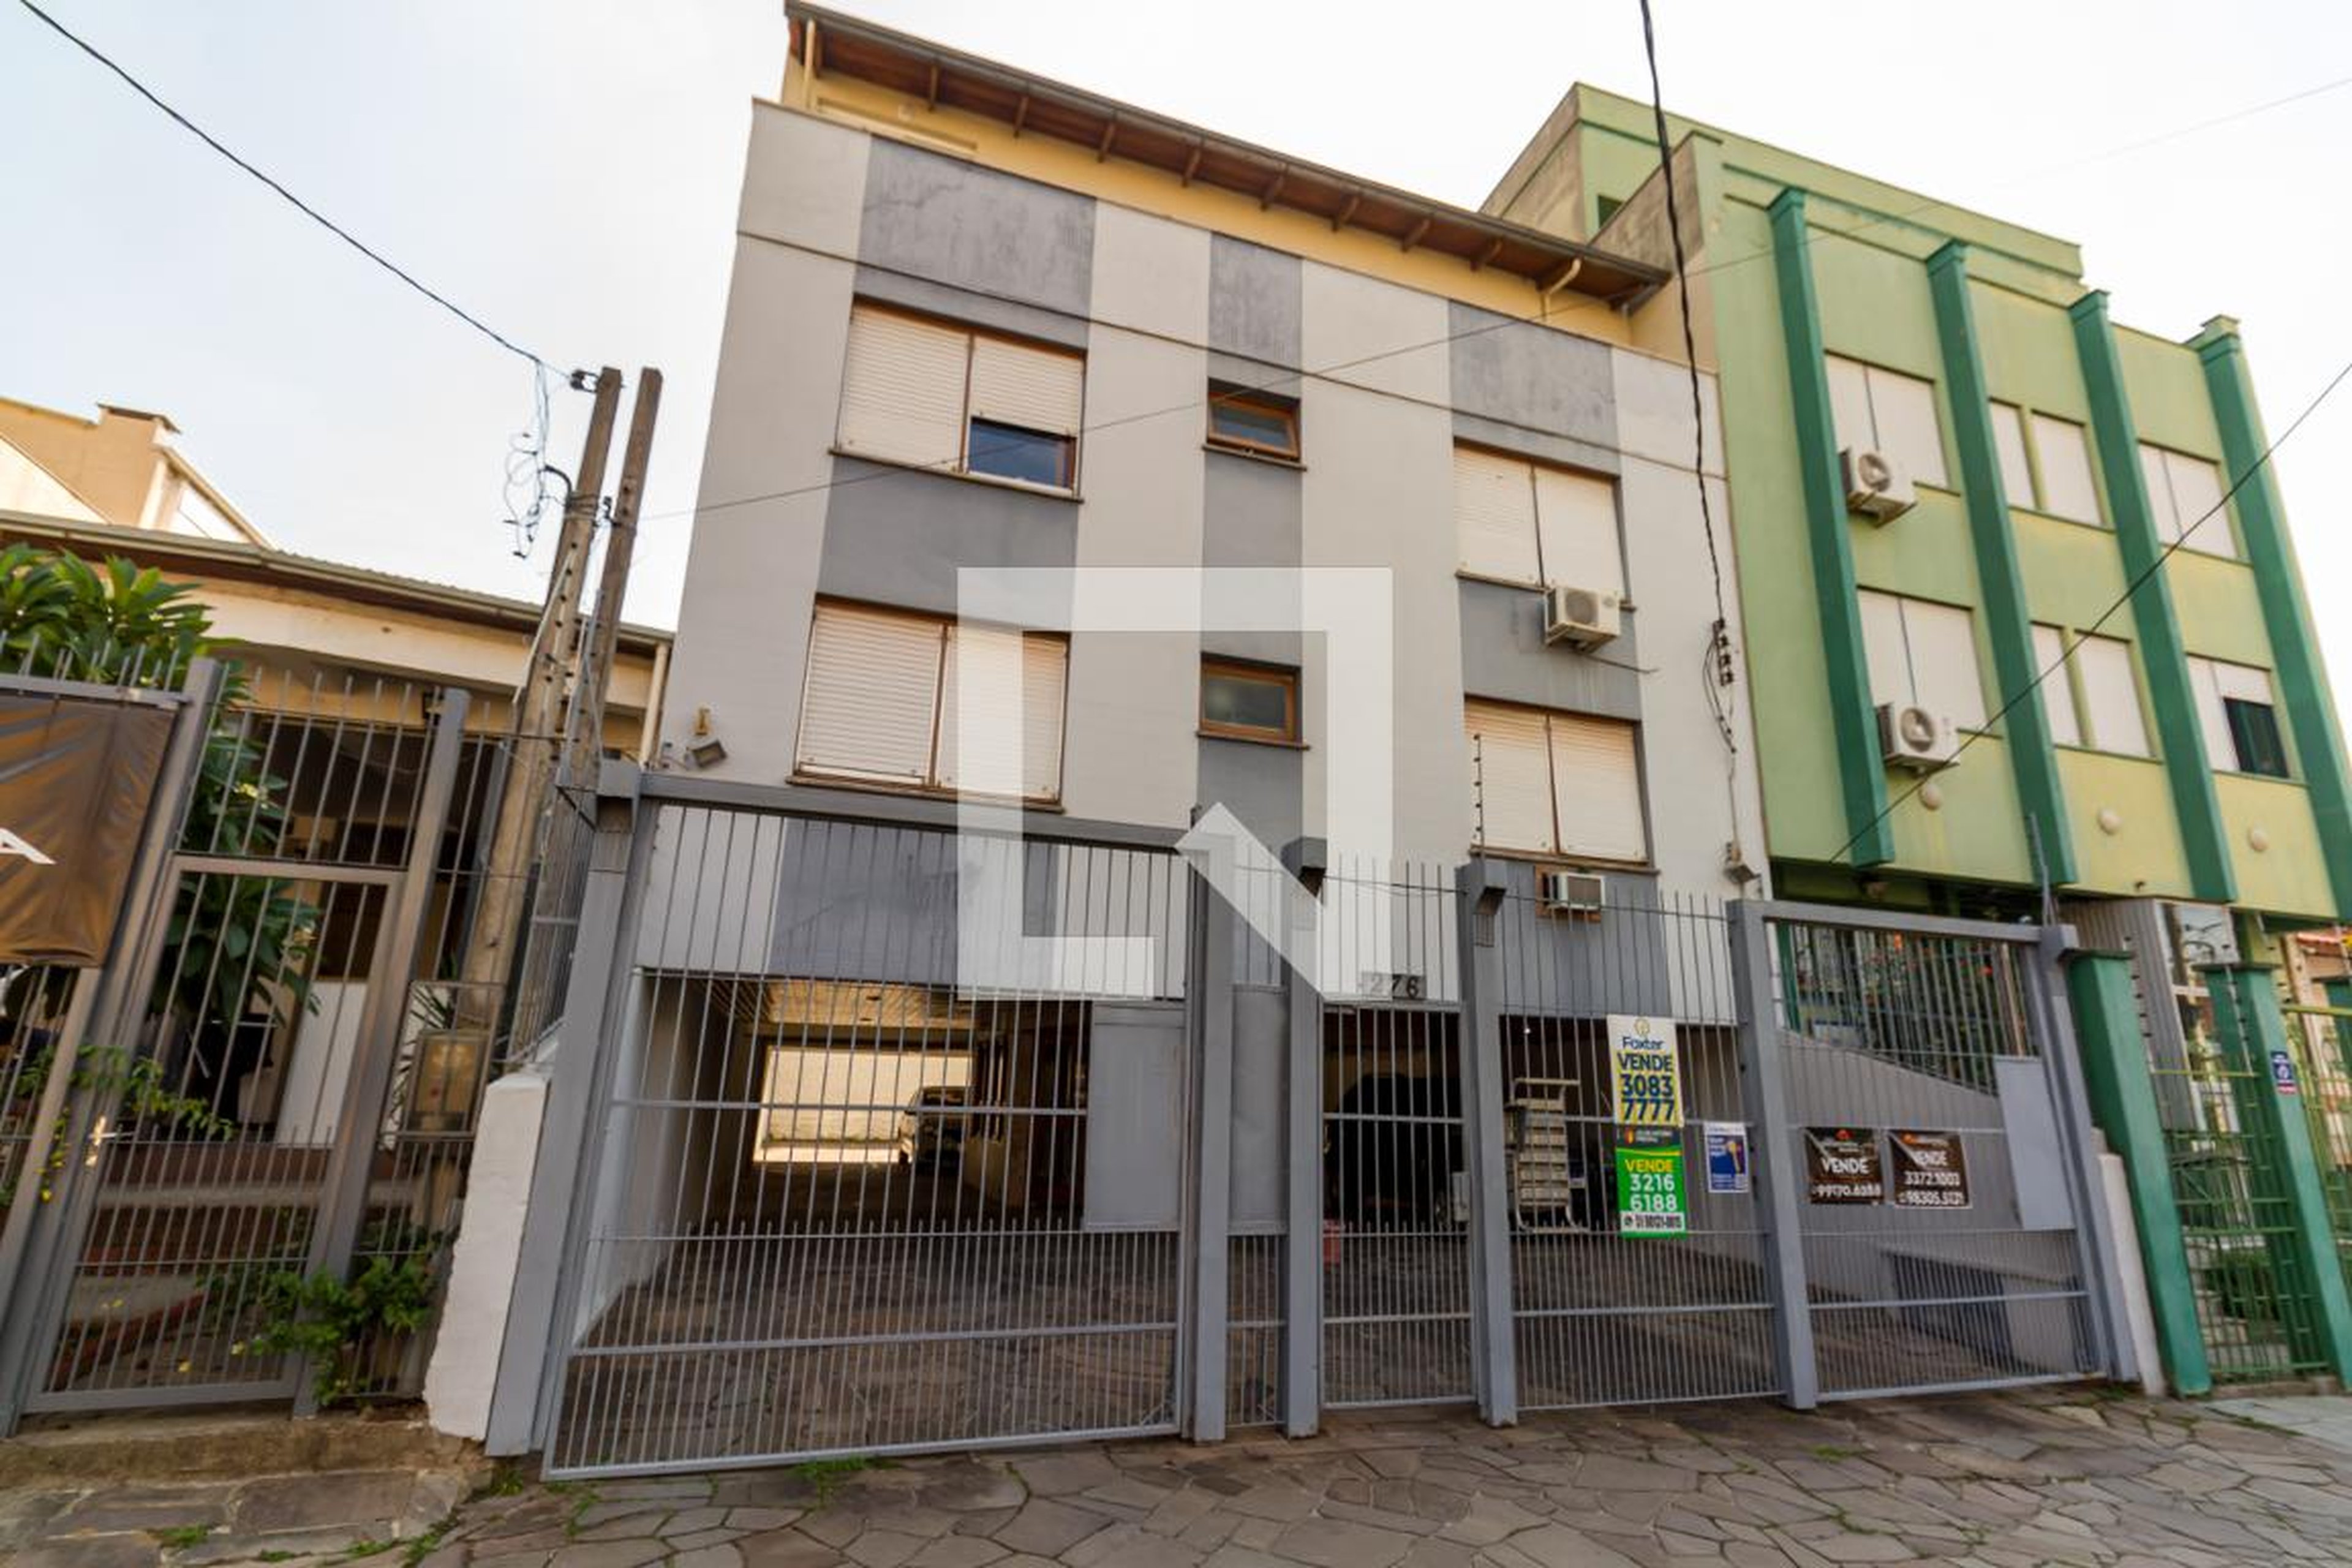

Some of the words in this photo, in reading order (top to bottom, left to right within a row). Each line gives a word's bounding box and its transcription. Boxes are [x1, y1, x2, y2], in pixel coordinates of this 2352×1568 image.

[1623, 1036, 1664, 1049] Foxter
[1617, 1053, 1673, 1072] VENDE
[1621, 1074, 1673, 1096] 3083
[1622, 1098, 1674, 1120] 7777
[1625, 1158, 1673, 1173] VENDE
[1820, 1157, 1869, 1174] VENDE
[1911, 1150, 1948, 1166] VENDE
[1630, 1174, 1675, 1191] 3216
[1630, 1194, 1677, 1211] 6188
